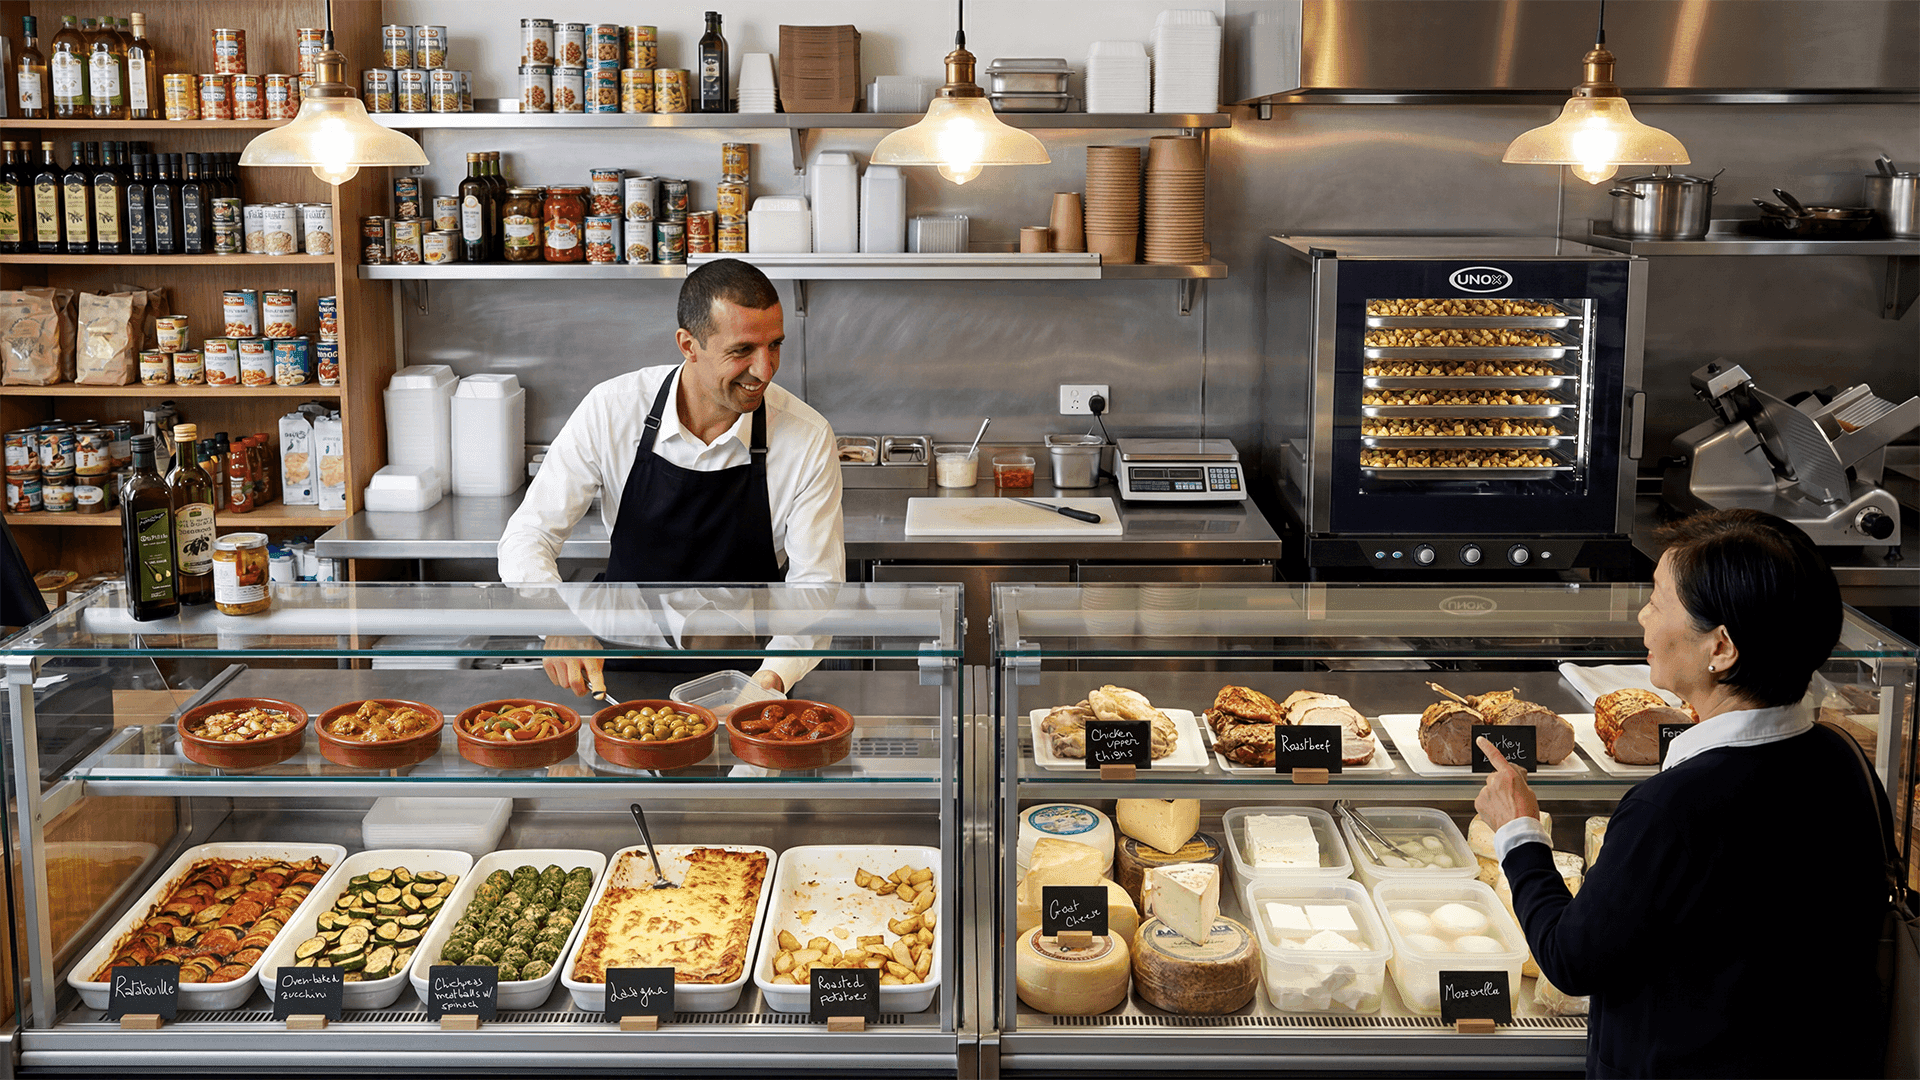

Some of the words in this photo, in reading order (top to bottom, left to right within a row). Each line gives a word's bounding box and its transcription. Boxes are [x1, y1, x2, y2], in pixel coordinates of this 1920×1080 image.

[1457, 274, 1502, 286] UNOX
[1091, 728, 1133, 742] Chicken
[1481, 732, 1521, 750] Trkey
[1107, 738, 1140, 749] upper
[1281, 734, 1331, 753] Roastbeef
[1050, 899, 1080, 920] Goat
[1065, 909, 1101, 928] Cheese
[115, 975, 175, 998] Ratatouille
[281, 973, 340, 988] Oven-baked
[818, 974, 864, 990] Roasted
[280, 988, 327, 1000] zucchini
[435, 988, 481, 1000] meatballs
[610, 981, 668, 1008] Lasagna
[820, 991, 867, 1007] potatoes
[1445, 981, 1500, 1001] Mozzarella
[441, 1000, 479, 1011] spinach
